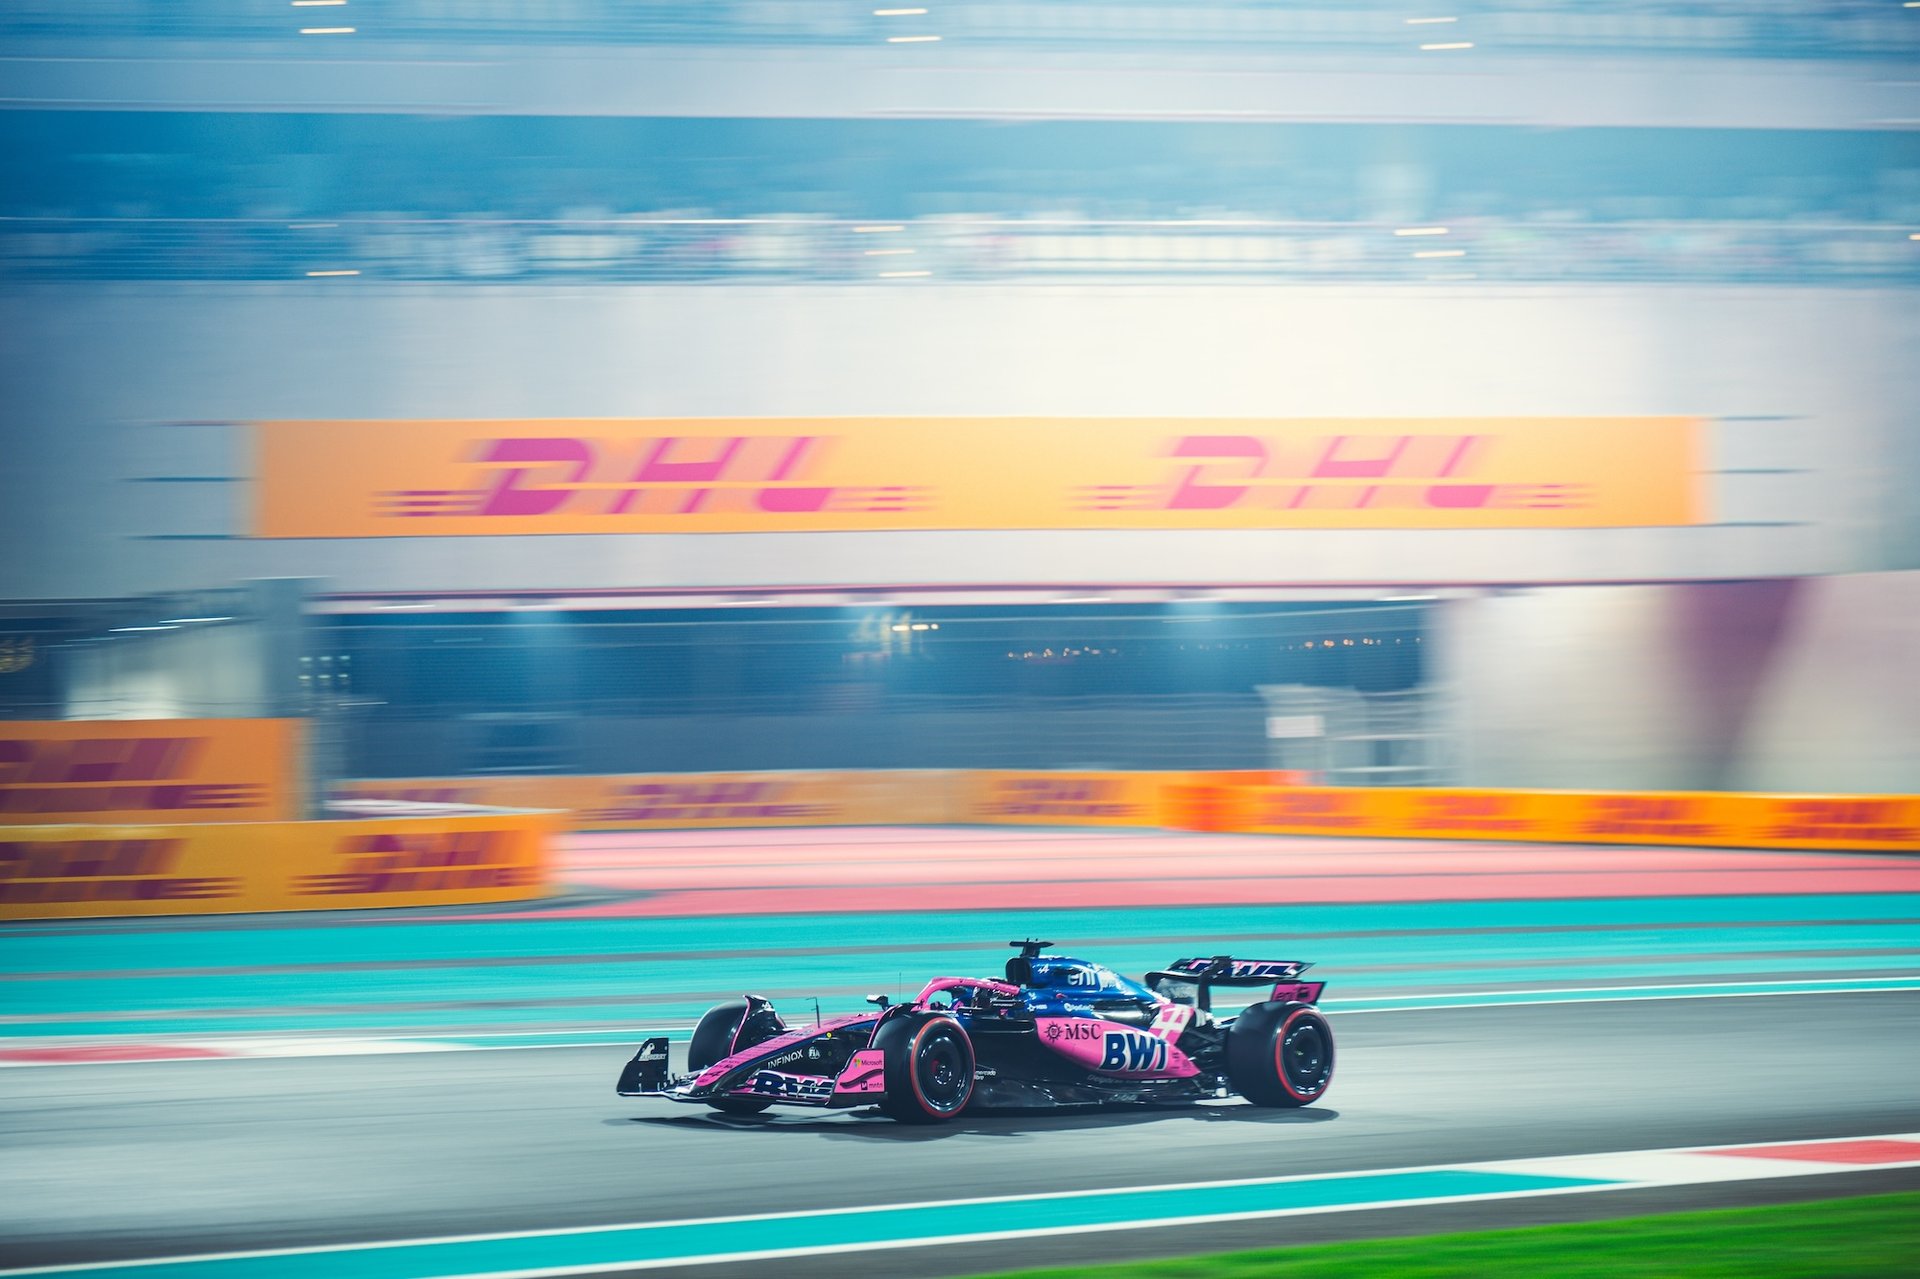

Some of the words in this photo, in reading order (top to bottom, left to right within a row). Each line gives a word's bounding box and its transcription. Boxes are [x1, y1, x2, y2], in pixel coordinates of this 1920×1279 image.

[455, 436, 845, 516] DHL
[1158, 434, 1495, 511] DHL
[1064, 1023, 1102, 1040] MSC
[767, 1049, 804, 1069] INFINOX
[808, 1048, 820, 1059] FIA
[1098, 1030, 1171, 1072] BWT
